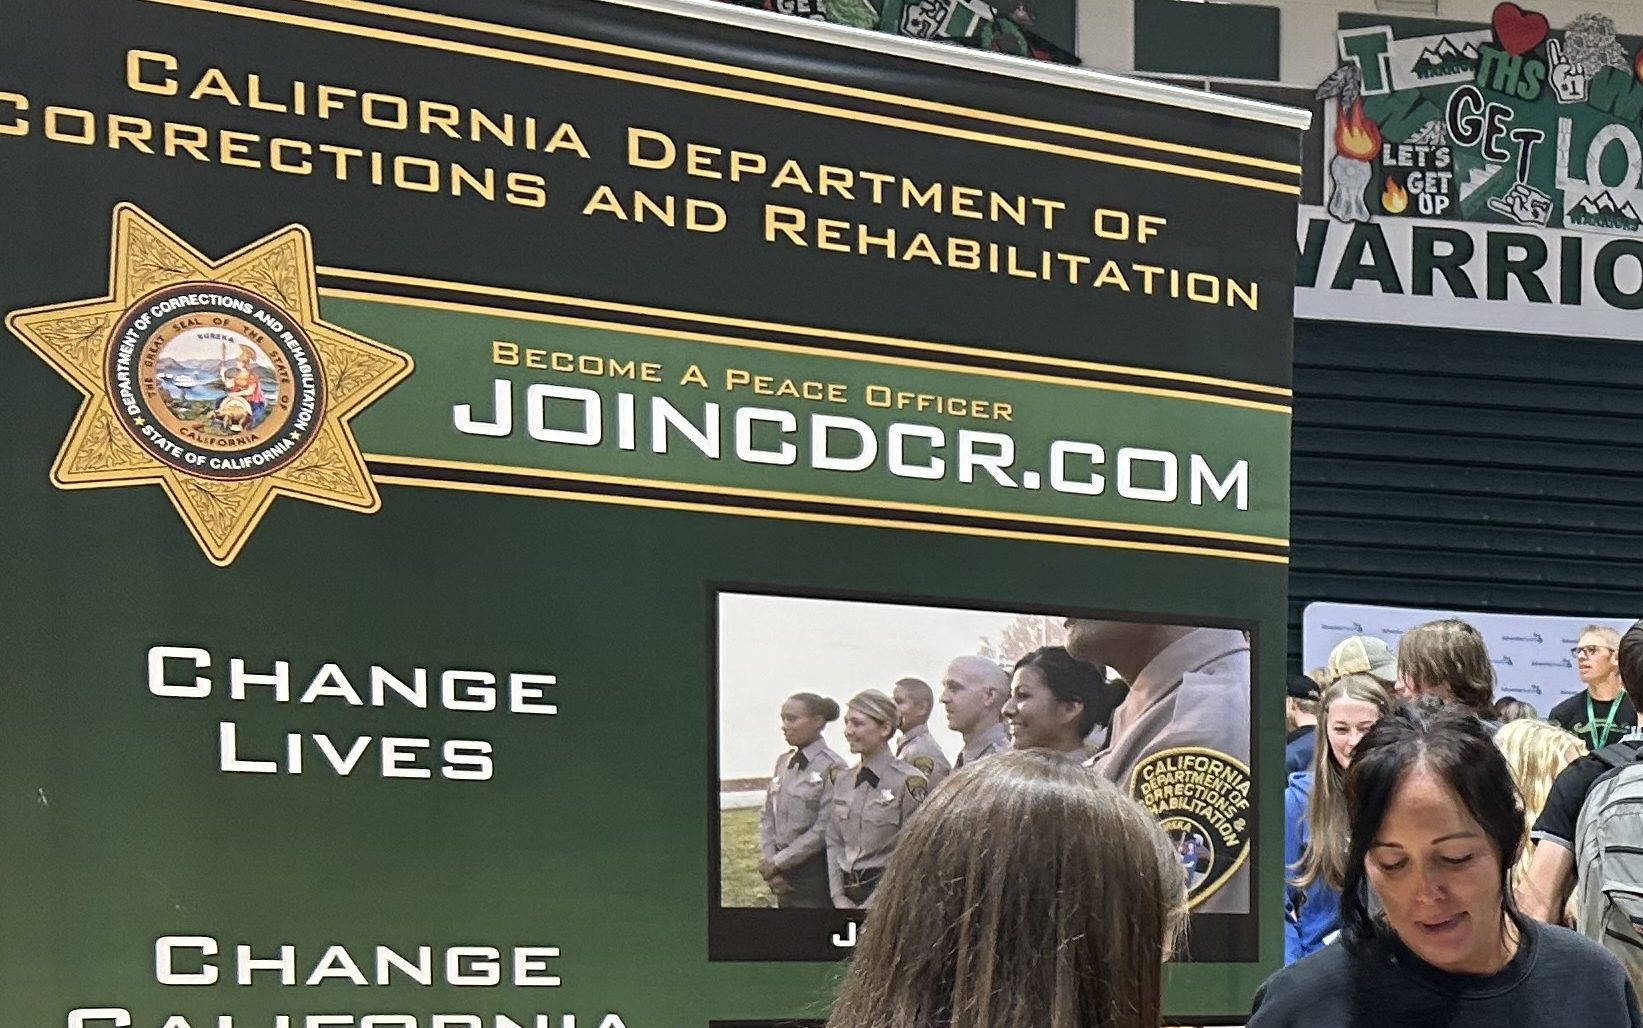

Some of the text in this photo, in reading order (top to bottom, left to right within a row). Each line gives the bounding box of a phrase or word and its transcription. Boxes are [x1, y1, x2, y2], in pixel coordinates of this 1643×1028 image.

[126, 49, 1168, 245] CALIFORNIA DEPARTMENT OF
[1383, 144, 1450, 166] LET'S
[1446, 85, 1545, 184] GET
[1407, 171, 1452, 194] GET
[1418, 193, 1450, 215] UP
[583, 184, 728, 234] AND
[764, 203, 1260, 311] REHABILITATION
[116, 293, 316, 432] DEPARTMENT OF CORRECTIONS AND REHABILITATION
[172, 317, 203, 333] SEAL
[212, 317, 230, 326] OF
[242, 325, 263, 343] THE
[268, 349, 289, 384] STATE
[196, 332, 235, 343] EUREKA
[492, 339, 1014, 422] BECOME A PEACE OFFICER
[141, 424, 296, 470] STATE OF CALIFORNIA
[179, 427, 259, 447] CALIFORNIA
[453, 378, 1249, 511] JOINCDCR.COM
[147, 646, 558, 715] CHANGE
[220, 721, 494, 781] LIVES
[1142, 755, 1251, 797] CALIFORNIA
[1140, 770, 1250, 811] DEPARTMENT OF
[1143, 783, 1246, 833] ORRECTIONS &
[155, 936, 562, 987] CHANGE
